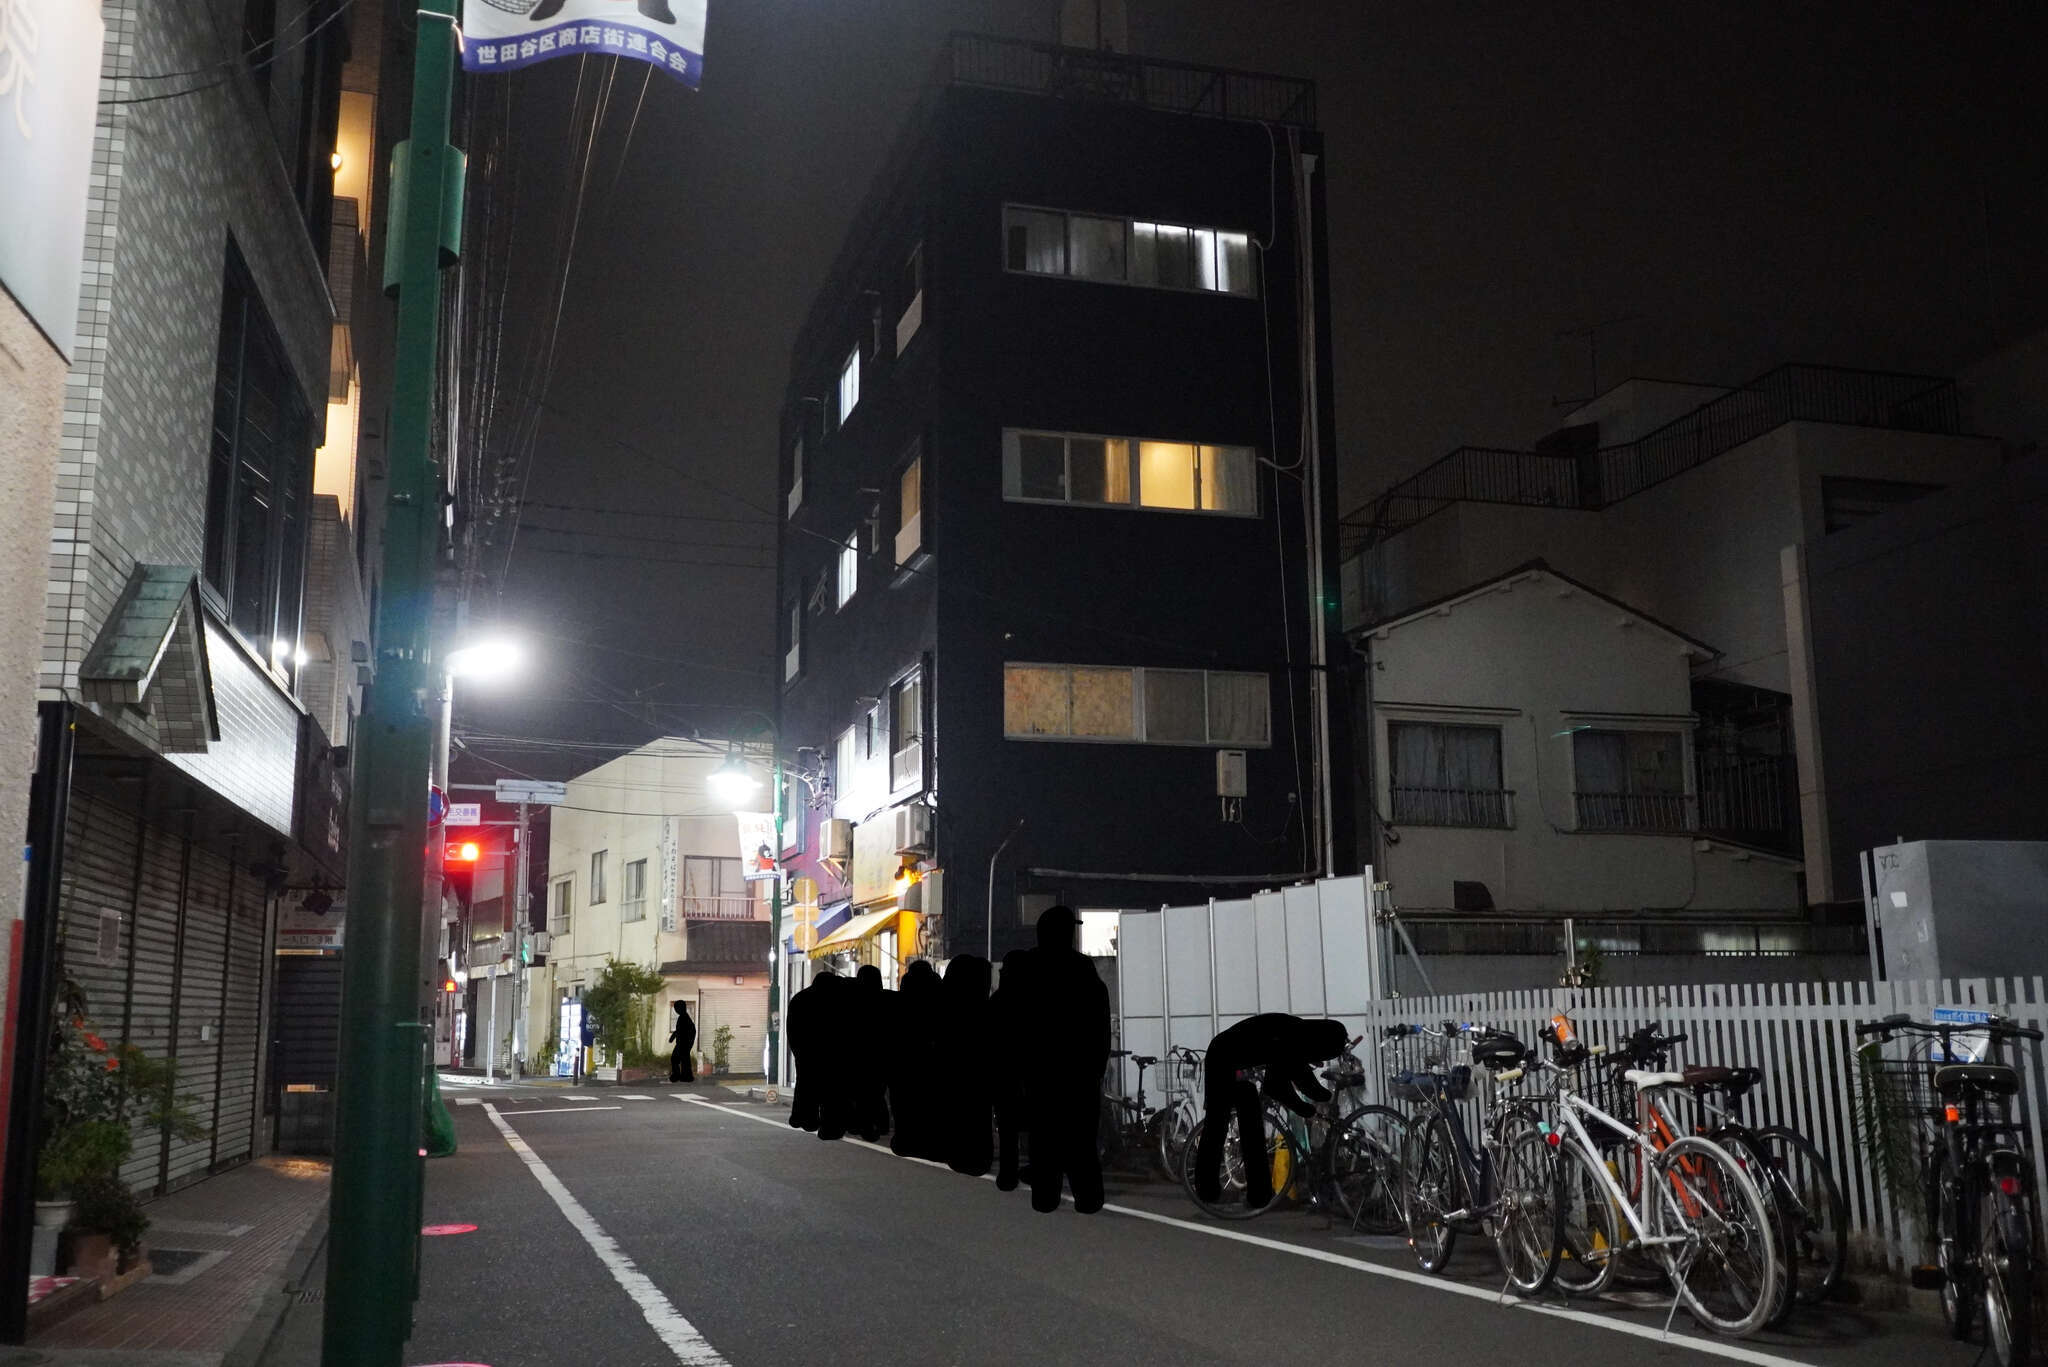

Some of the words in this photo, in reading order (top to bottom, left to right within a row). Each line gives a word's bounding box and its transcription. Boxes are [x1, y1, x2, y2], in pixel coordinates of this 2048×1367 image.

[477, 26, 687, 74] 世田谷区商店街連合会
